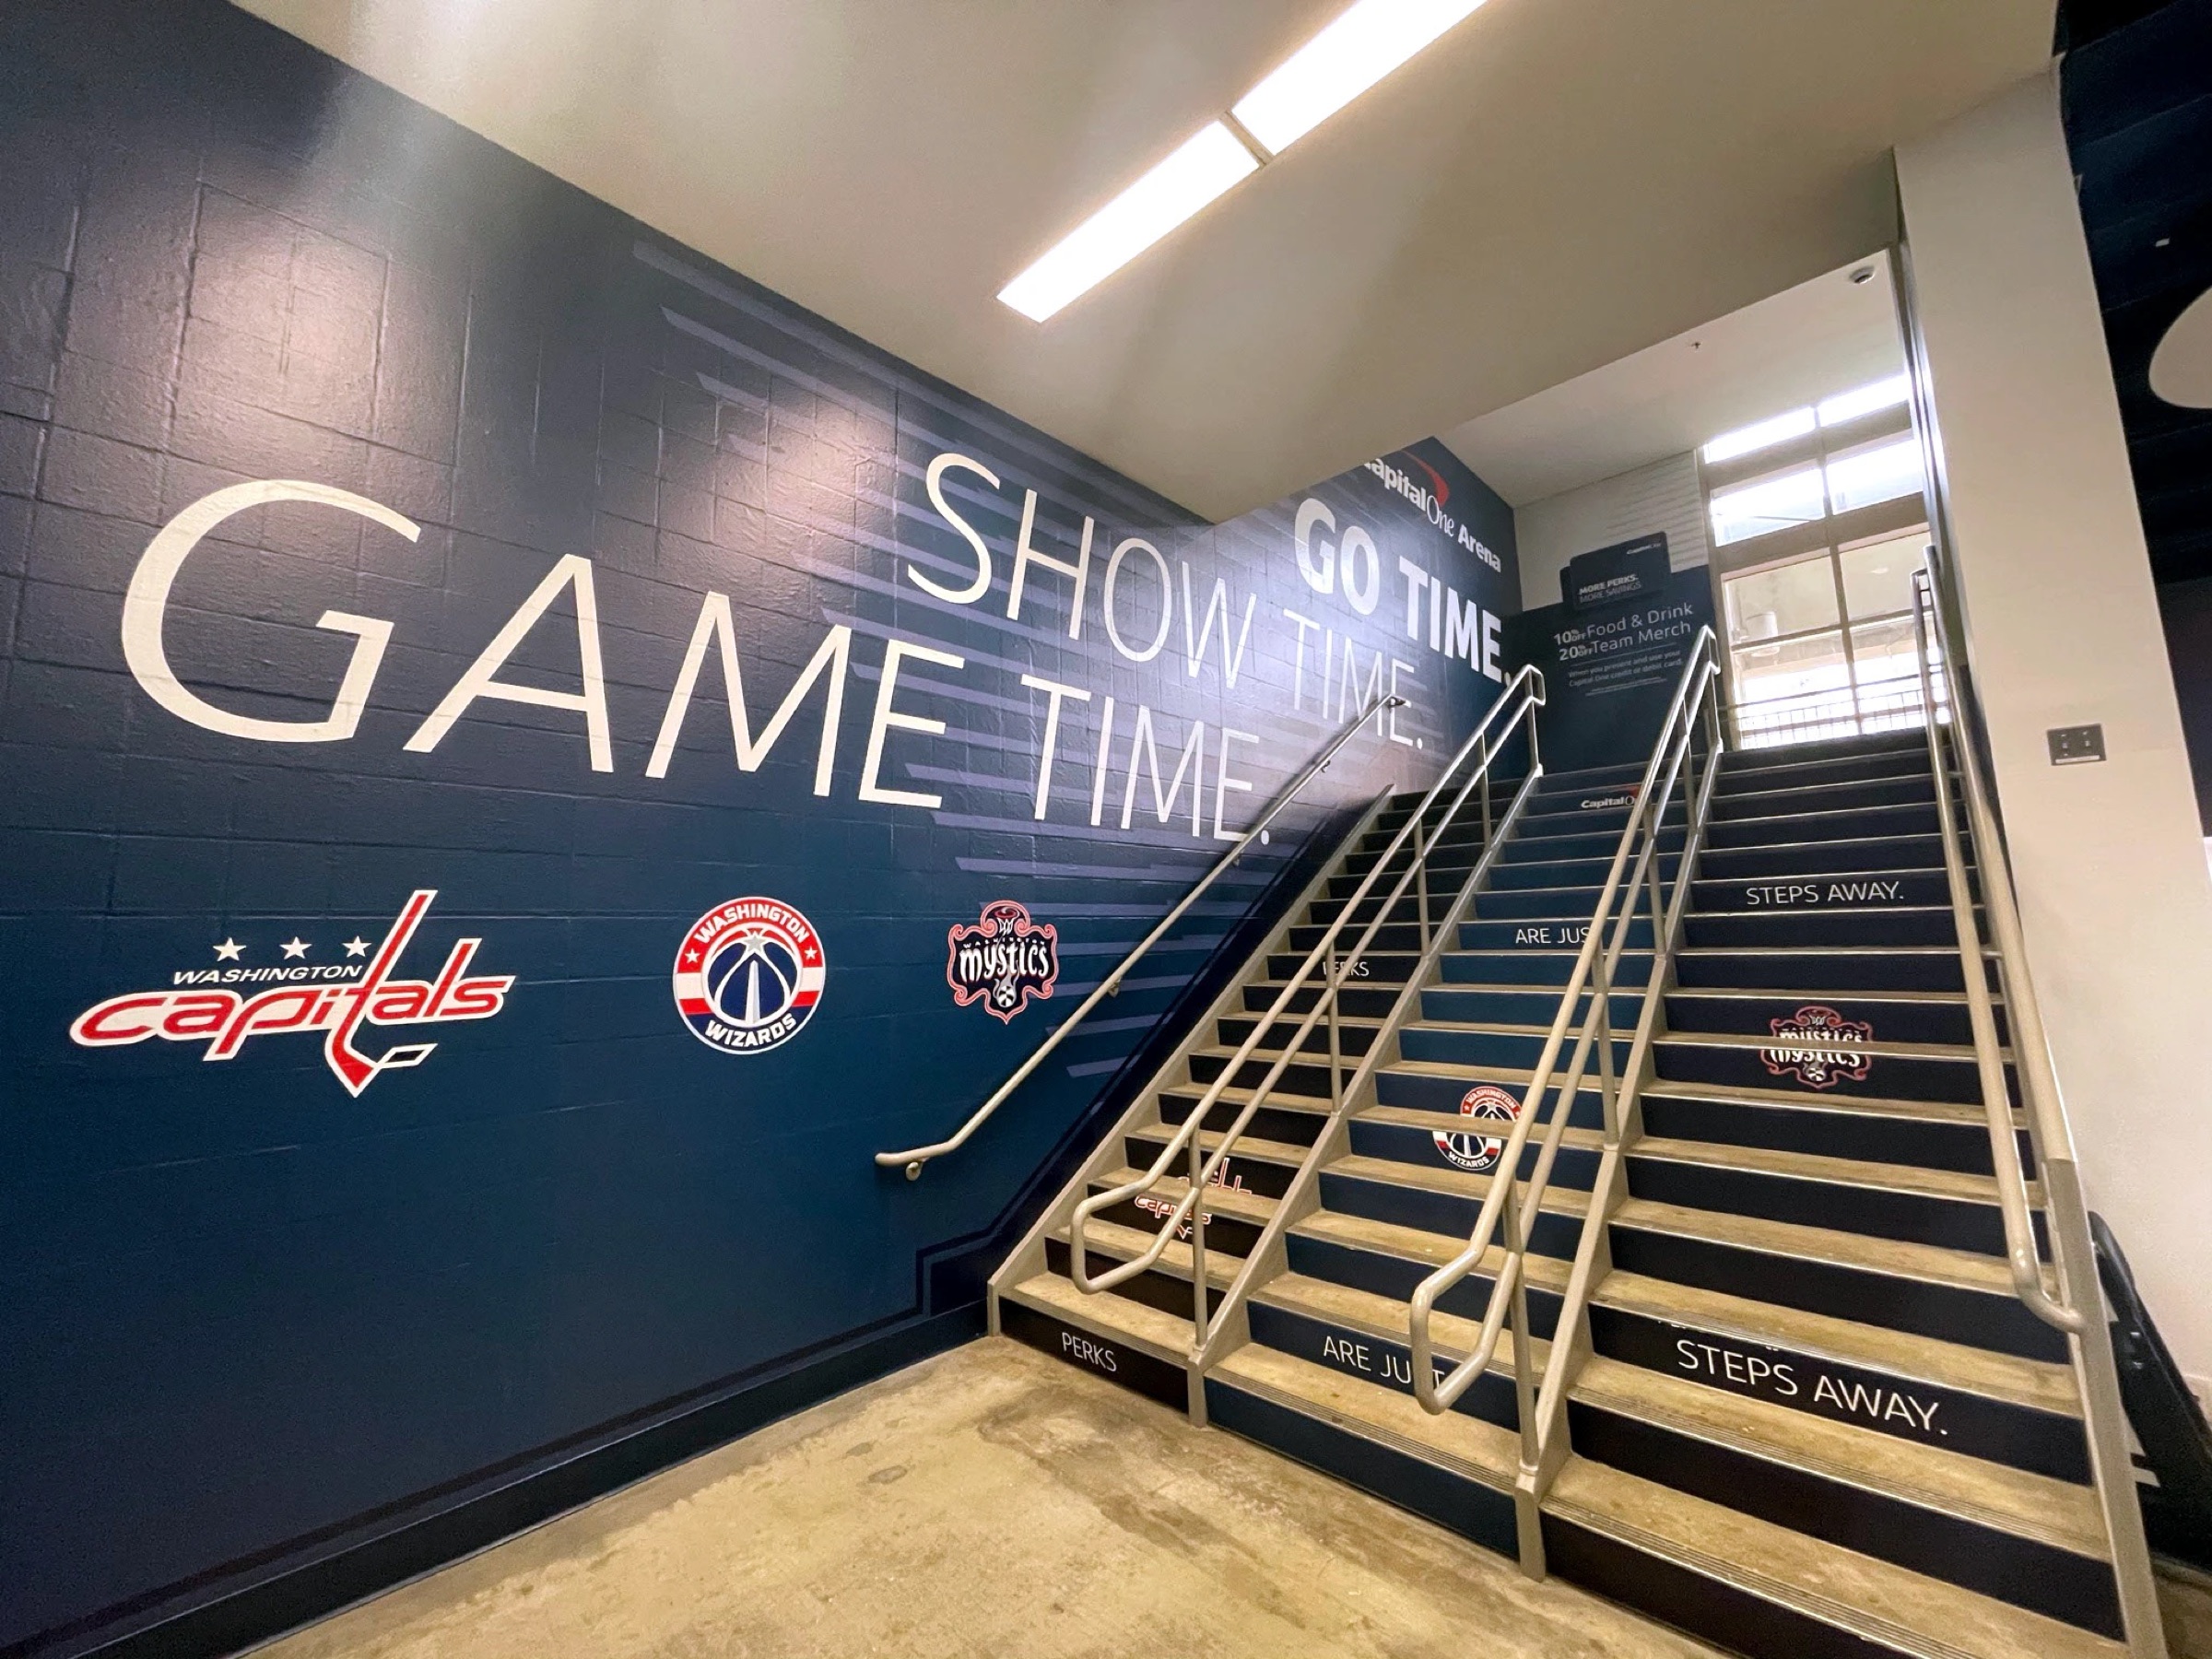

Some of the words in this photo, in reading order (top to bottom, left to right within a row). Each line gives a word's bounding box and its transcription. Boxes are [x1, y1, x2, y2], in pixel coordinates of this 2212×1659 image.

[1458, 524, 1501, 572] Arena
[908, 453, 1257, 689] SHOW
[1283, 608, 1422, 749] TIME.
[1295, 498, 1380, 615] GO
[1399, 556, 1512, 688] TIME.
[1586, 617, 1627, 638] Food
[1631, 614, 1642, 628] &
[1647, 602, 1694, 624] Drink
[1591, 635, 1633, 653] Team
[1639, 620, 1691, 644] Merch
[121, 478, 965, 808] GAME
[1020, 674, 1269, 845] TIME.
[1746, 885, 1819, 905] STEPS
[1828, 880, 1904, 901] AWAY.
[694, 903, 809, 944] WASHINGTON
[1515, 927, 1551, 944] ARE
[1557, 926, 1591, 944] JUS
[70, 889, 515, 1098] capitals
[172, 965, 363, 984] WASHINGTON
[704, 1013, 797, 1048] WIZARDS
[1465, 1088, 1516, 1109] WASHINGTON
[1448, 1150, 1489, 1168] WIZARDS
[1061, 1331, 1117, 1372] PERKS
[1323, 1335, 1371, 1371] ARE
[1380, 1354, 1445, 1387] JUT
[1677, 1339, 1798, 1396] STEPS
[1814, 1375, 1948, 1435] AWAY.
